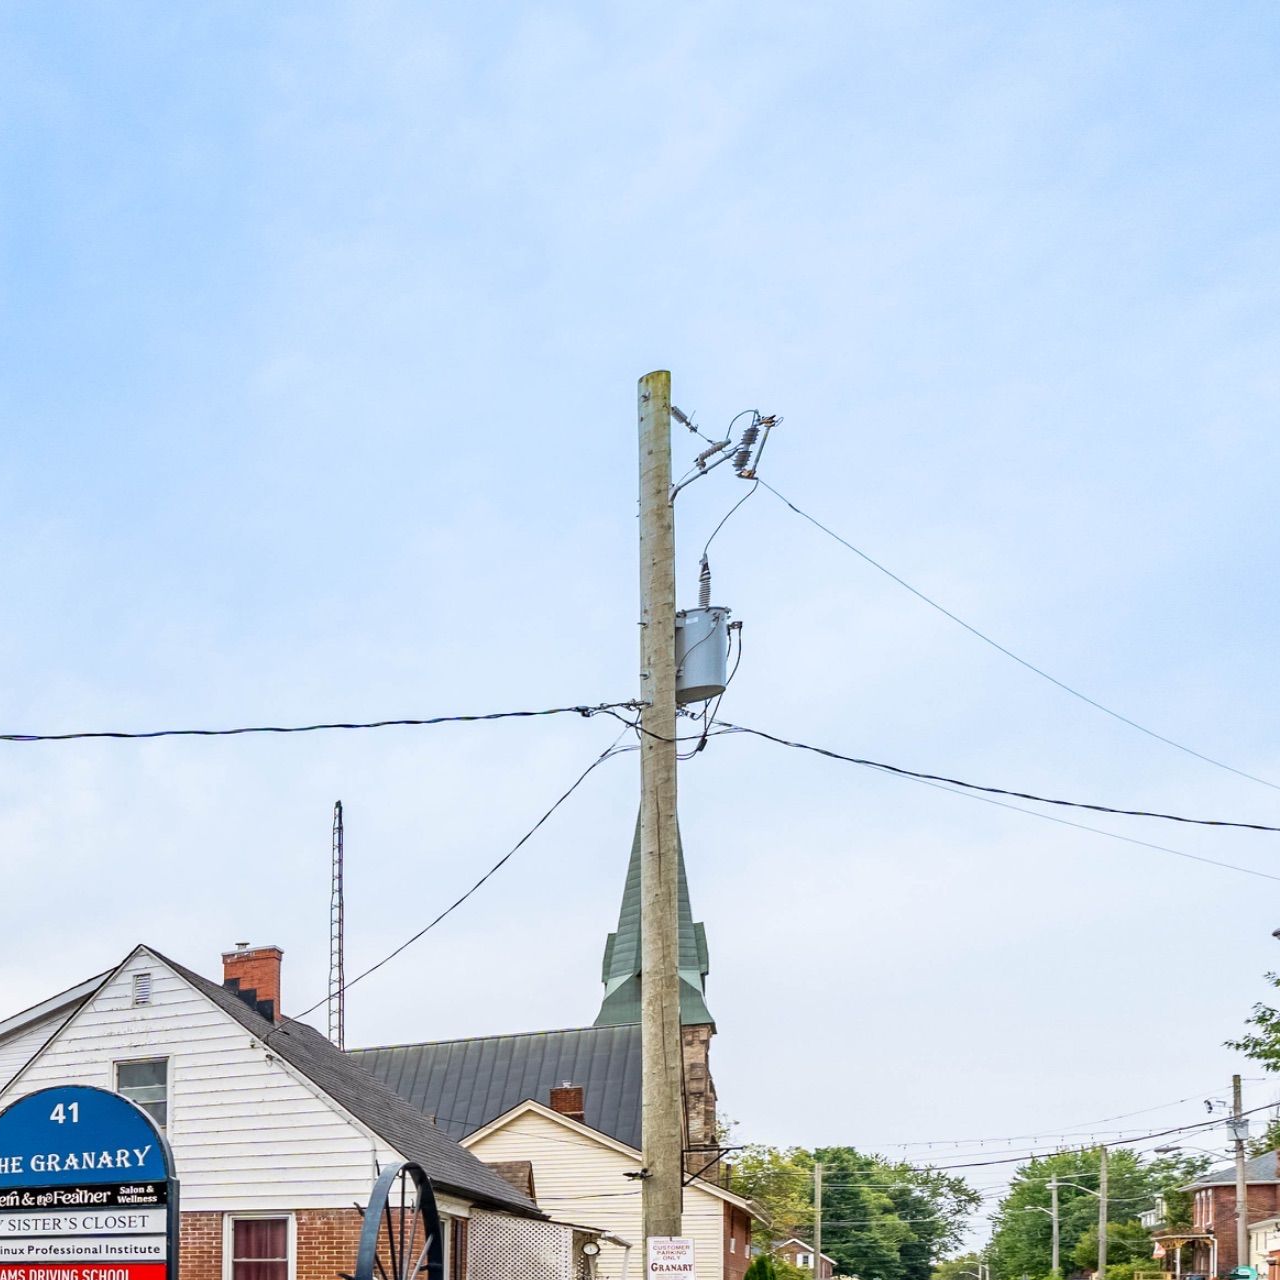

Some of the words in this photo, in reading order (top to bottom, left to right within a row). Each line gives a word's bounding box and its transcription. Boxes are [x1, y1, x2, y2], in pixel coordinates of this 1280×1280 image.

[49, 1102, 79, 1124] 41
[30, 1144, 152, 1172] GRANARY
[119, 1186, 144, 1194] Salon
[146, 1185, 155, 1193] &
[22, 1191, 35, 1206] &
[117, 1194, 158, 1204] Wellness
[82, 1215, 149, 1229] CLOSET
[27, 1244, 102, 1255] Professional
[105, 1244, 161, 1254] Institute
